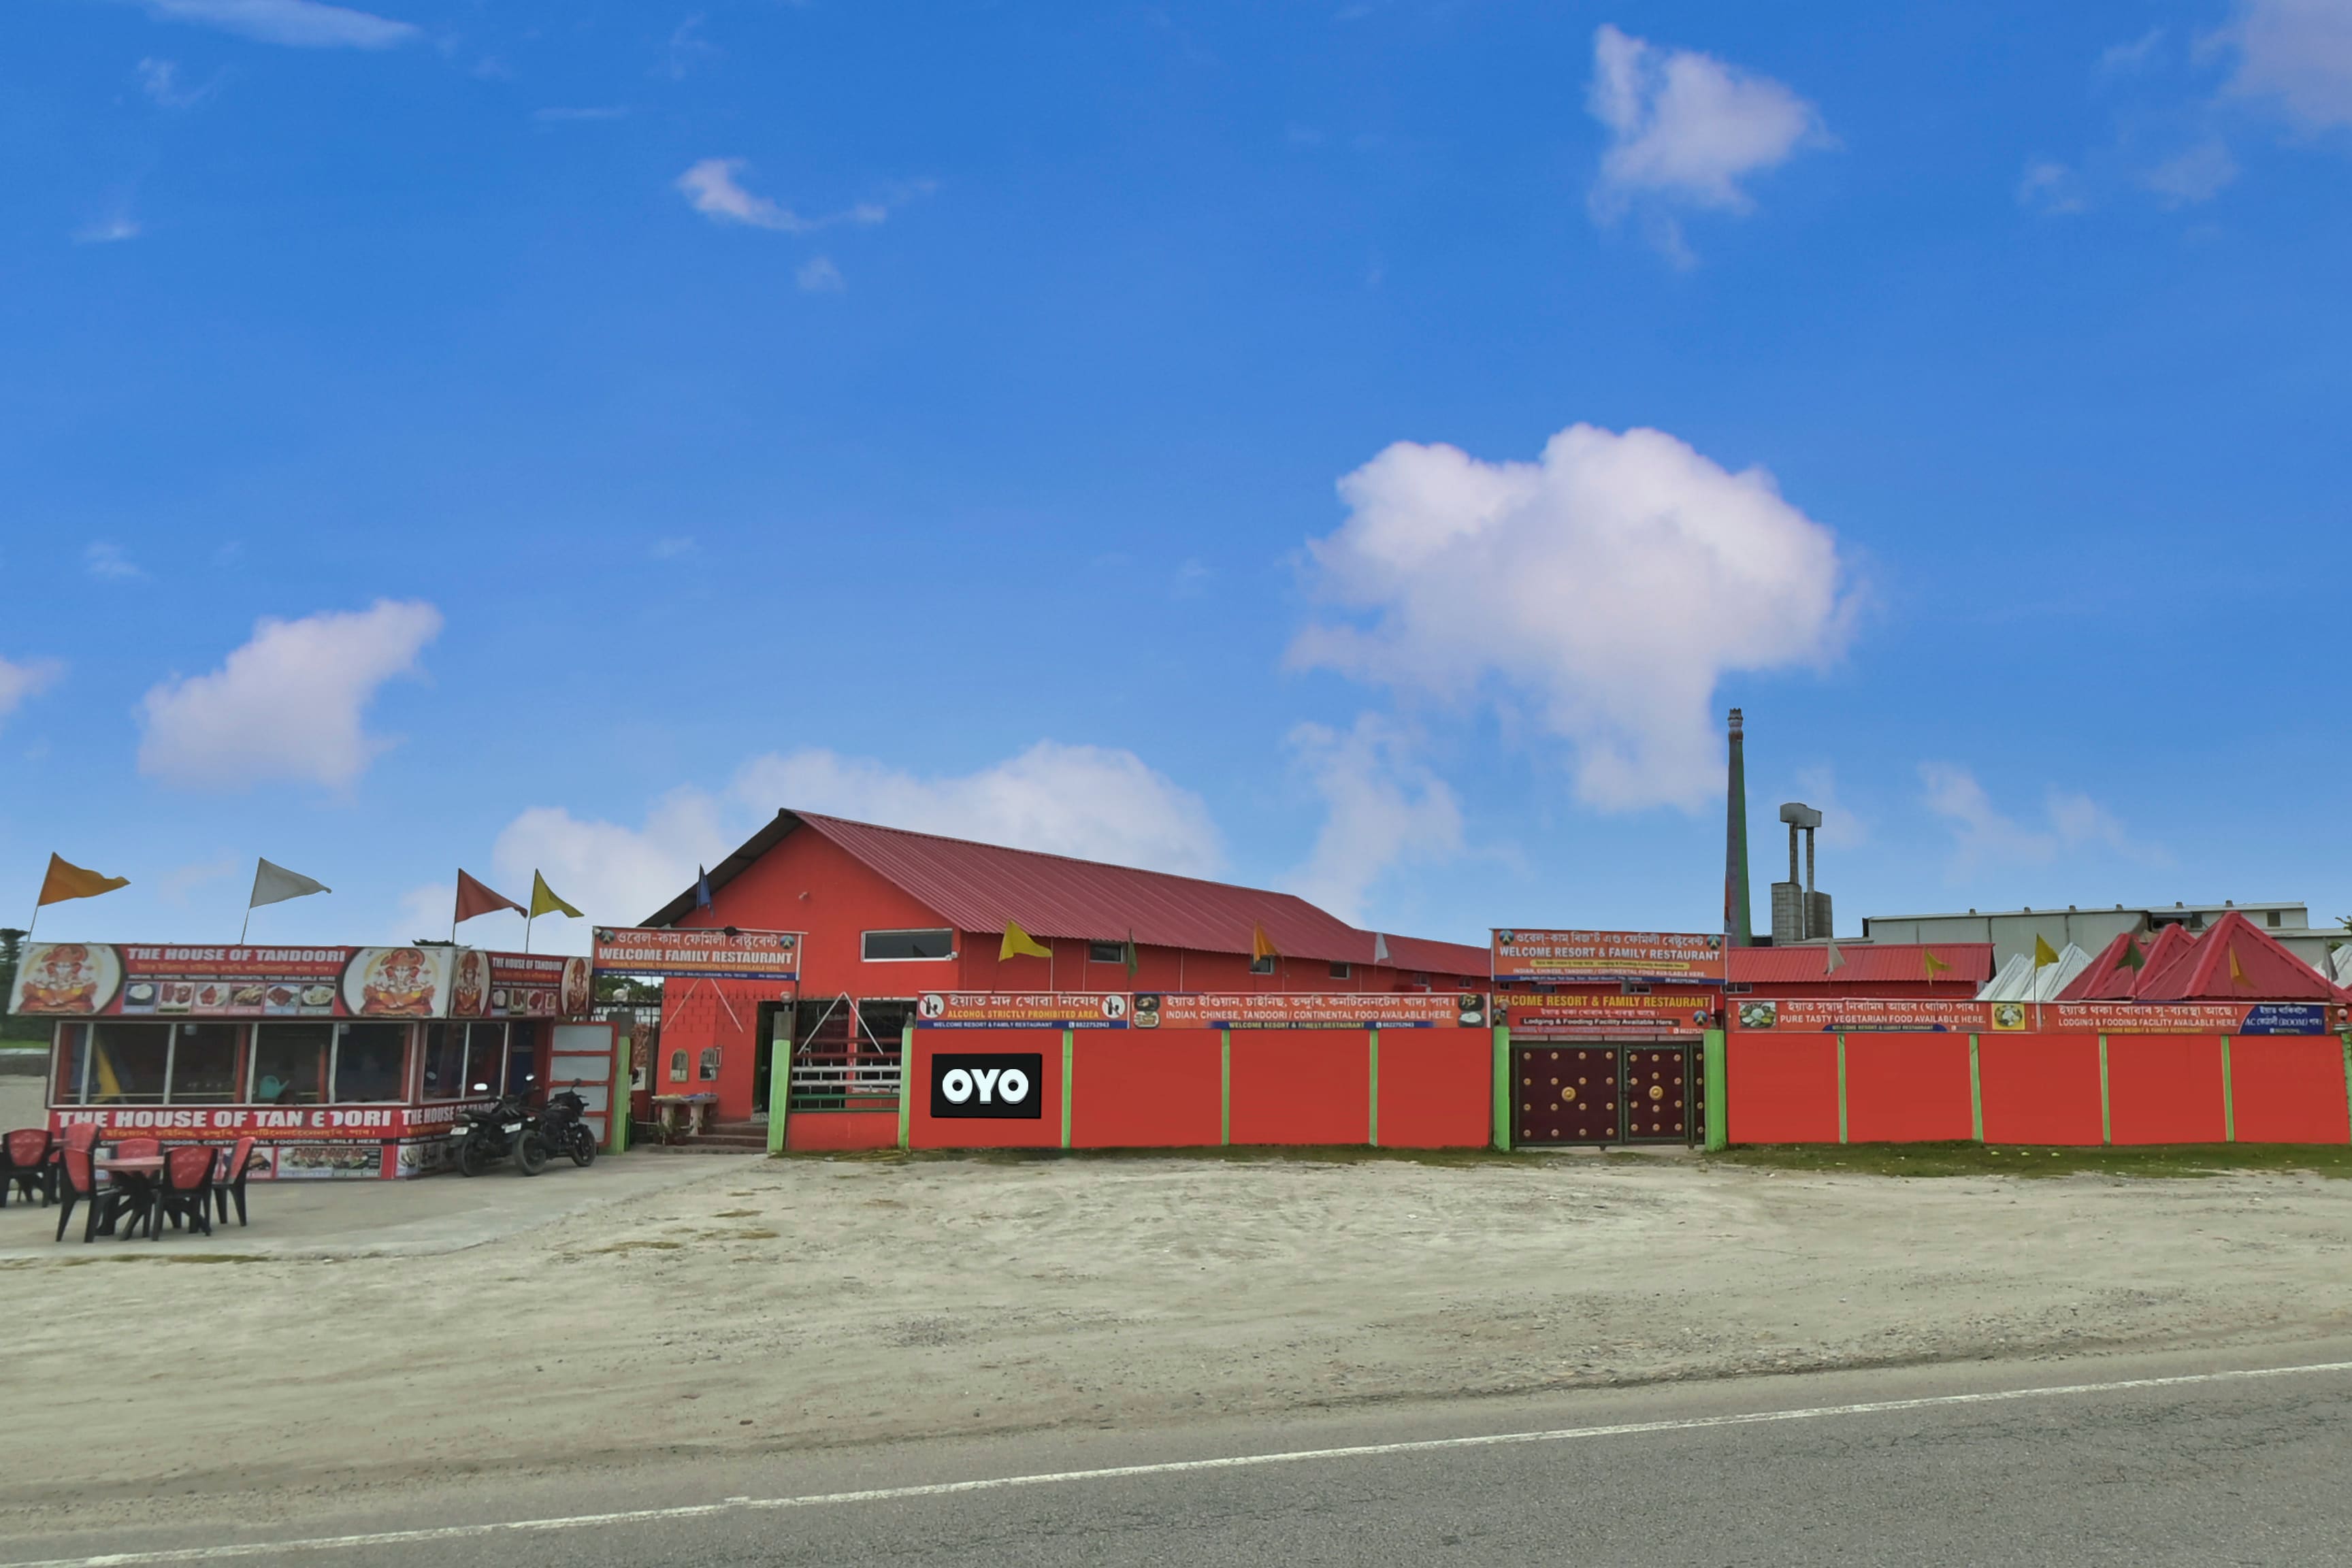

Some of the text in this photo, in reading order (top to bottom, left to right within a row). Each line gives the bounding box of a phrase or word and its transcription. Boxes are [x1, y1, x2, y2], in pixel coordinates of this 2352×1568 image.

[127, 948, 346, 962] THE HOUSE OF TANDOORI
[599, 947, 793, 964] WELCOME FAMILY RESTAURANT
[1499, 947, 1720, 961] WELCOME RESORT & FAMILY RESTAURANT
[493, 957, 504, 968] THE
[505, 958, 525, 970] HOUSE
[990, 996, 1011, 1007] মদ
[1546, 996, 1588, 1006] RESORT
[1591, 996, 1599, 1007] &
[1603, 996, 1640, 1007] FAMILY
[1644, 996, 1710, 1007] RESTAURANT
[947, 1010, 1099, 1019] ALCOHOL STRICTLY PROHIBITED AREA
[1166, 1011, 1198, 1019] INDIAN,
[1200, 1011, 1241, 1019] CHINESE,
[1243, 1011, 1288, 1019] TANDOORI
[1294, 1011, 1353, 1019] CONTINENTAL
[1355, 1011, 1379, 1019] FOOD
[1380, 1011, 1426, 1019] AVAILABLE
[1780, 1015, 1803, 1023] PURE
[1806, 1015, 1832, 1023] TASTY
[1834, 1015, 1887, 1023] VEGETARIAN
[1889, 1015, 1912, 1023] FOOD
[942, 1068, 1029, 1105] OYO
[57, 1111, 109, 1128] THE
[114, 1111, 206, 1128] HOUSE
[214, 1111, 248, 1127] OF
[402, 1109, 423, 1126] THE
[424, 1106, 455, 1124] HOUSE
